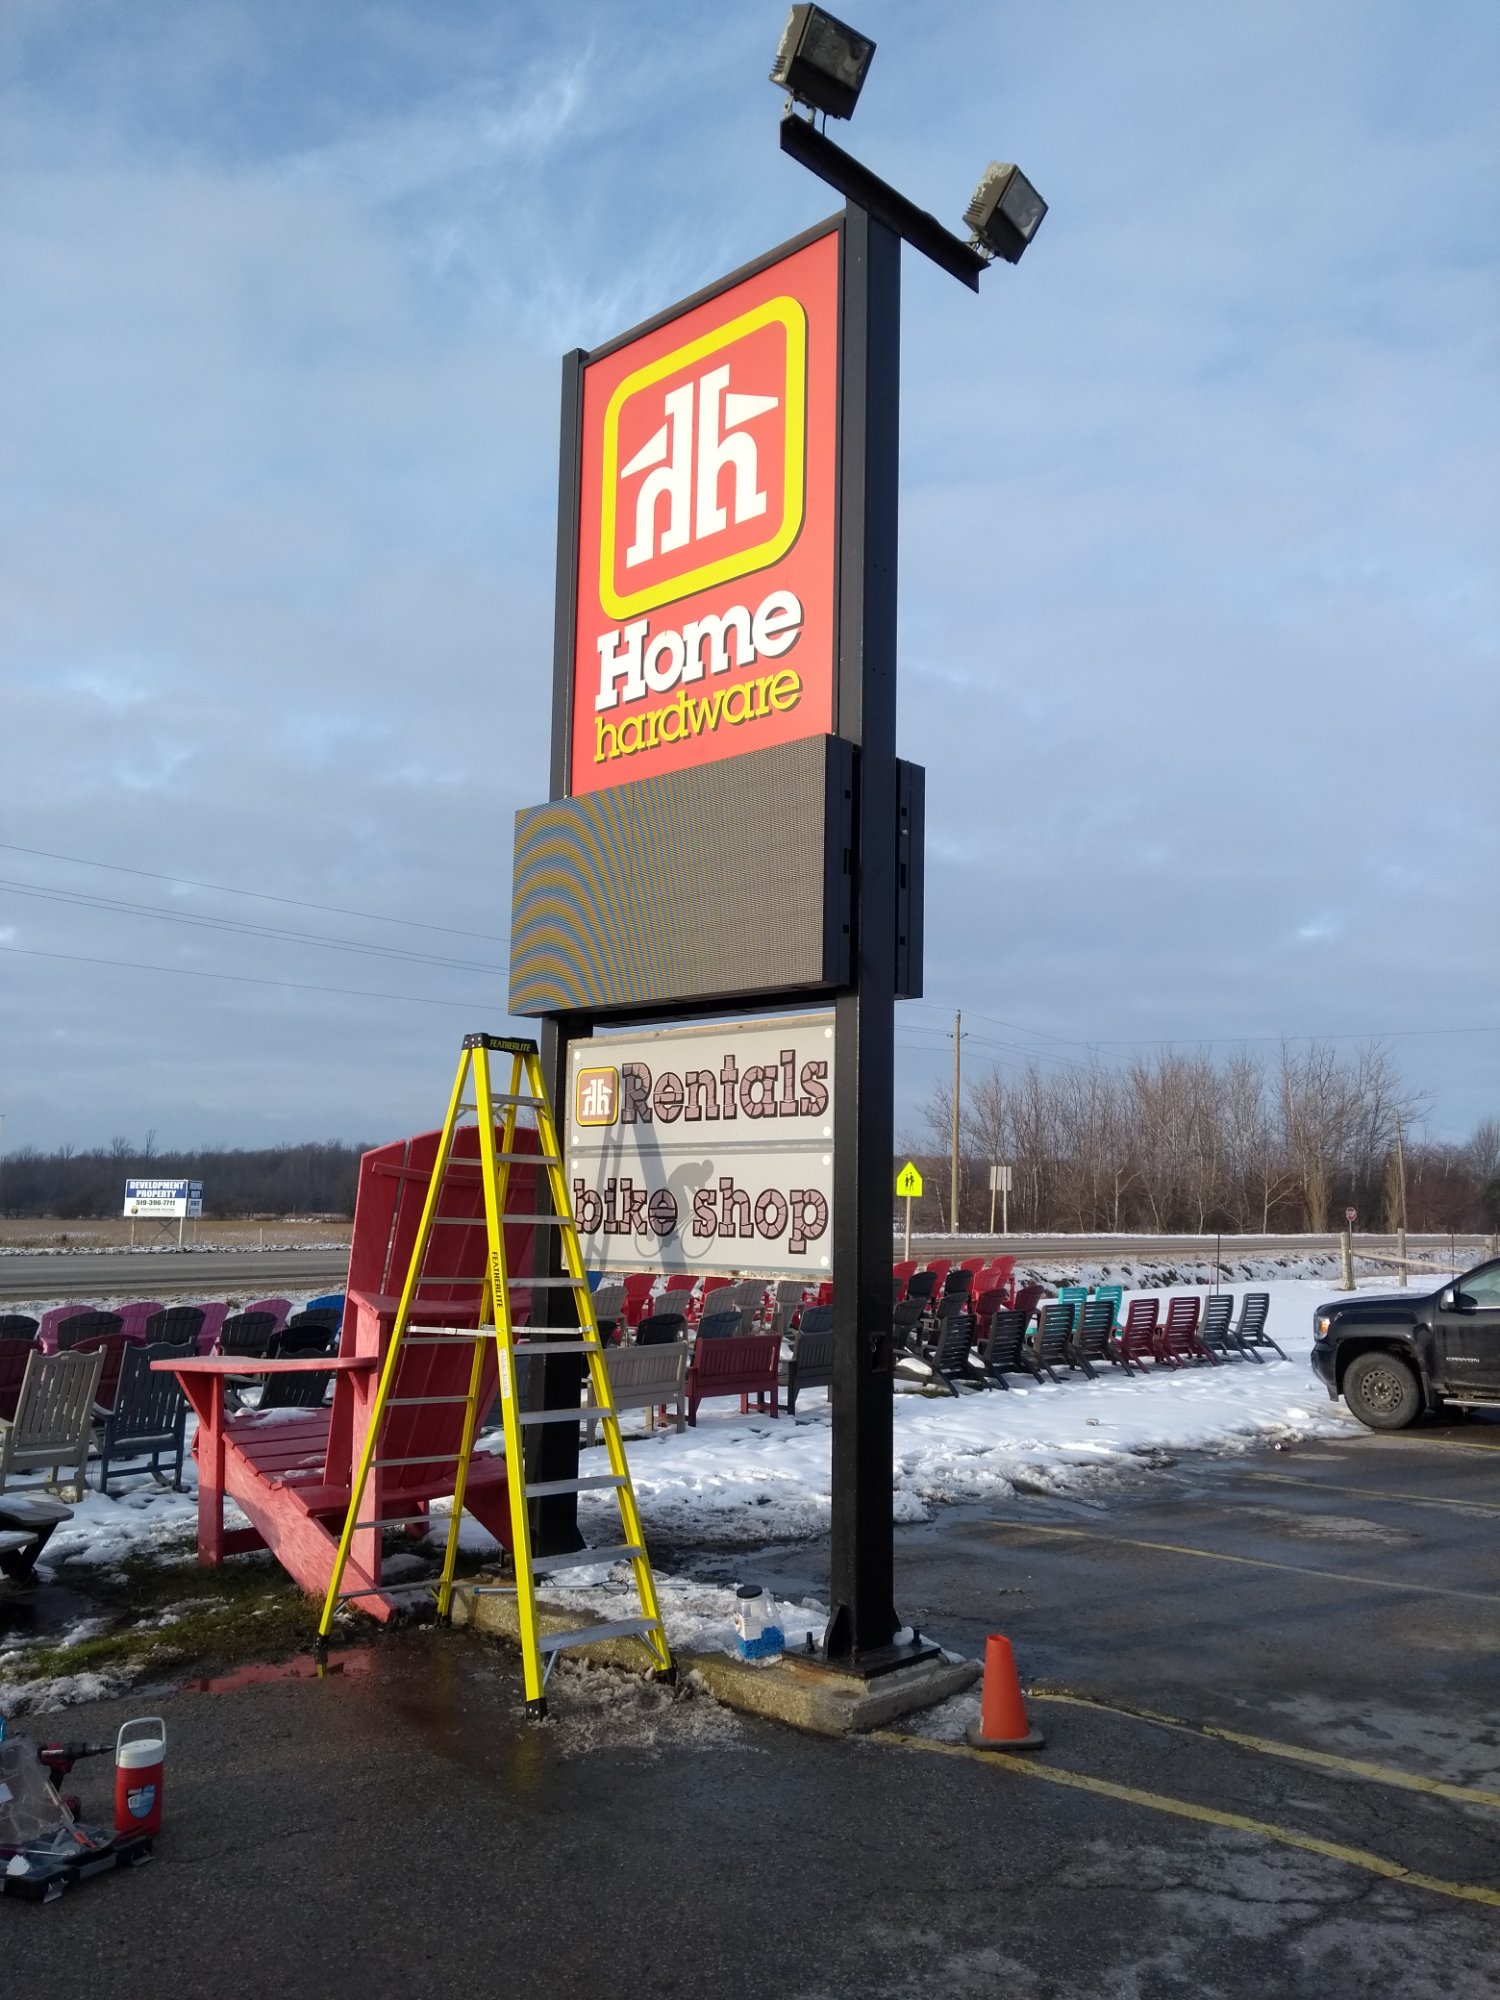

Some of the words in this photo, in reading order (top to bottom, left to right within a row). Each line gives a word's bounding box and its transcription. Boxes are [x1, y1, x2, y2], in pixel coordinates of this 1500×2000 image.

[594, 589, 804, 712] Home
[593, 668, 803, 765] hardware
[490, 1039, 532, 1052] FEATHERLITE
[621, 1049, 829, 1124] Rentals
[130, 1182, 184, 1190] DEVELOPMENT
[136, 1190, 177, 1198] PROPERTY
[573, 1177, 679, 1238] bike
[692, 1176, 829, 1255] shop
[491, 1251, 503, 1308] FEATHERLITE
